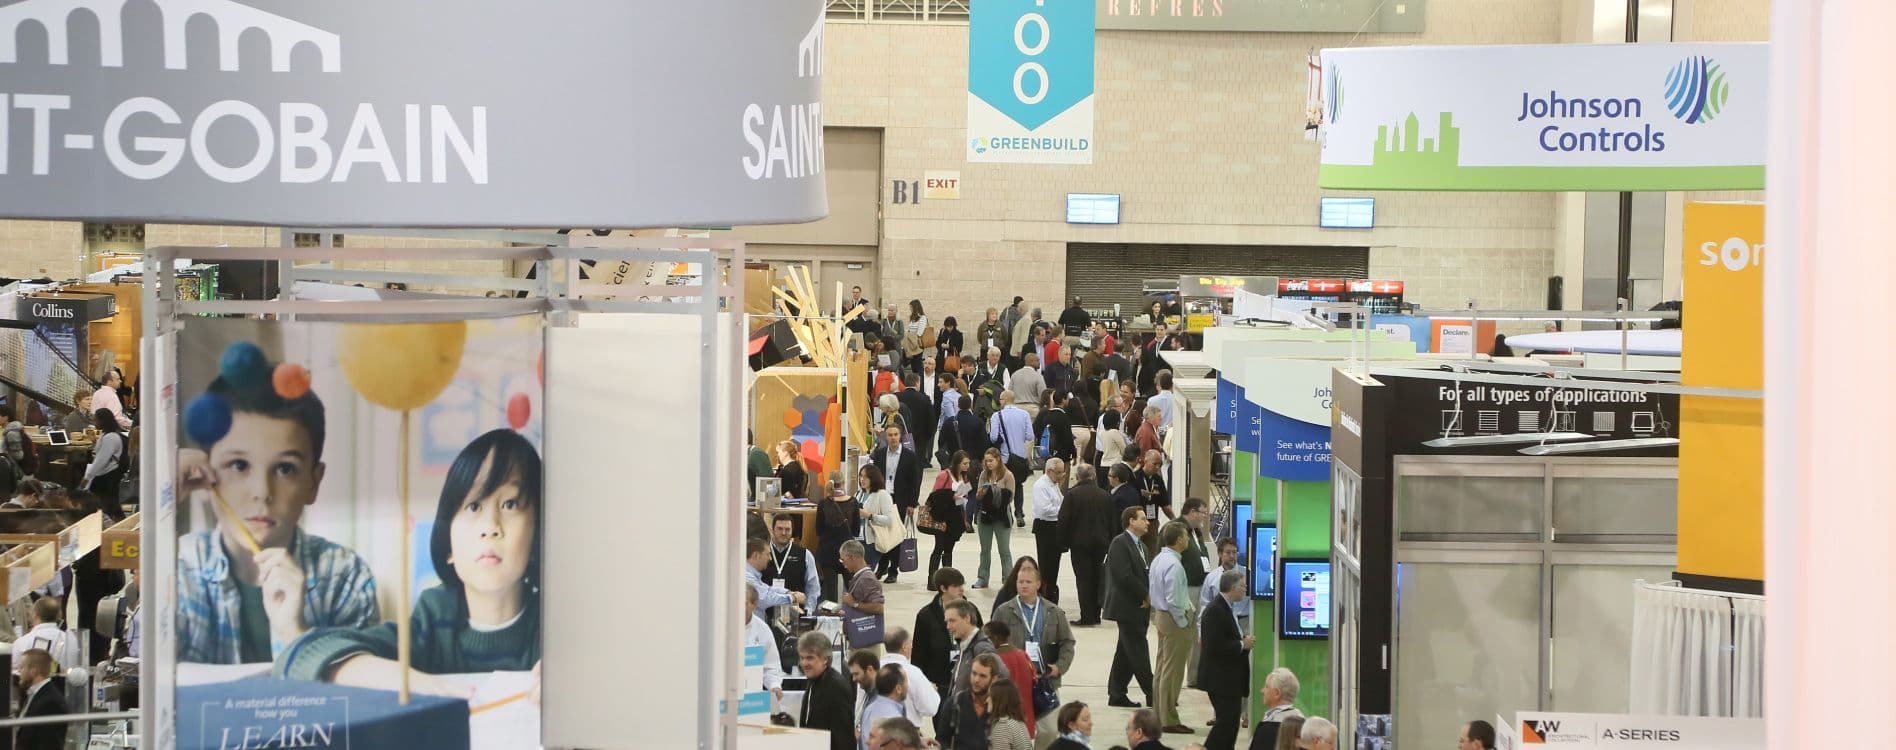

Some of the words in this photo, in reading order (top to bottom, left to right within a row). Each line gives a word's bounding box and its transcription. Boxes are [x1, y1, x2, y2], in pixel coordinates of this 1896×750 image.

[1518, 91, 1642, 121] Johnson
[0, 93, 488, 184] T-GOBAIN
[990, 137, 1089, 151] GREENBUILD
[1539, 124, 1665, 151] Controls
[926, 179, 958, 189] EXIT
[892, 180, 919, 204] B1
[32, 303, 74, 318] Collins
[1313, 387, 1332, 399] Joh
[1439, 386, 1464, 402] For
[1467, 387, 1486, 402] all
[1490, 388, 1530, 405] types
[1535, 387, 1552, 403] of
[1555, 388, 1648, 406] applications
[1277, 440, 1293, 449] See
[1295, 441, 1323, 450] what's
[1277, 452, 1301, 462] future
[1303, 453, 1313, 462] of
[1314, 454, 1332, 463] GRE
[225, 700, 233, 710] A
[235, 697, 276, 709] material
[278, 695, 327, 707] difference
[255, 709, 277, 719] how
[279, 708, 298, 720] you
[219, 722, 336, 750] LEARN
[1602, 728, 1680, 742] A-SERIES
